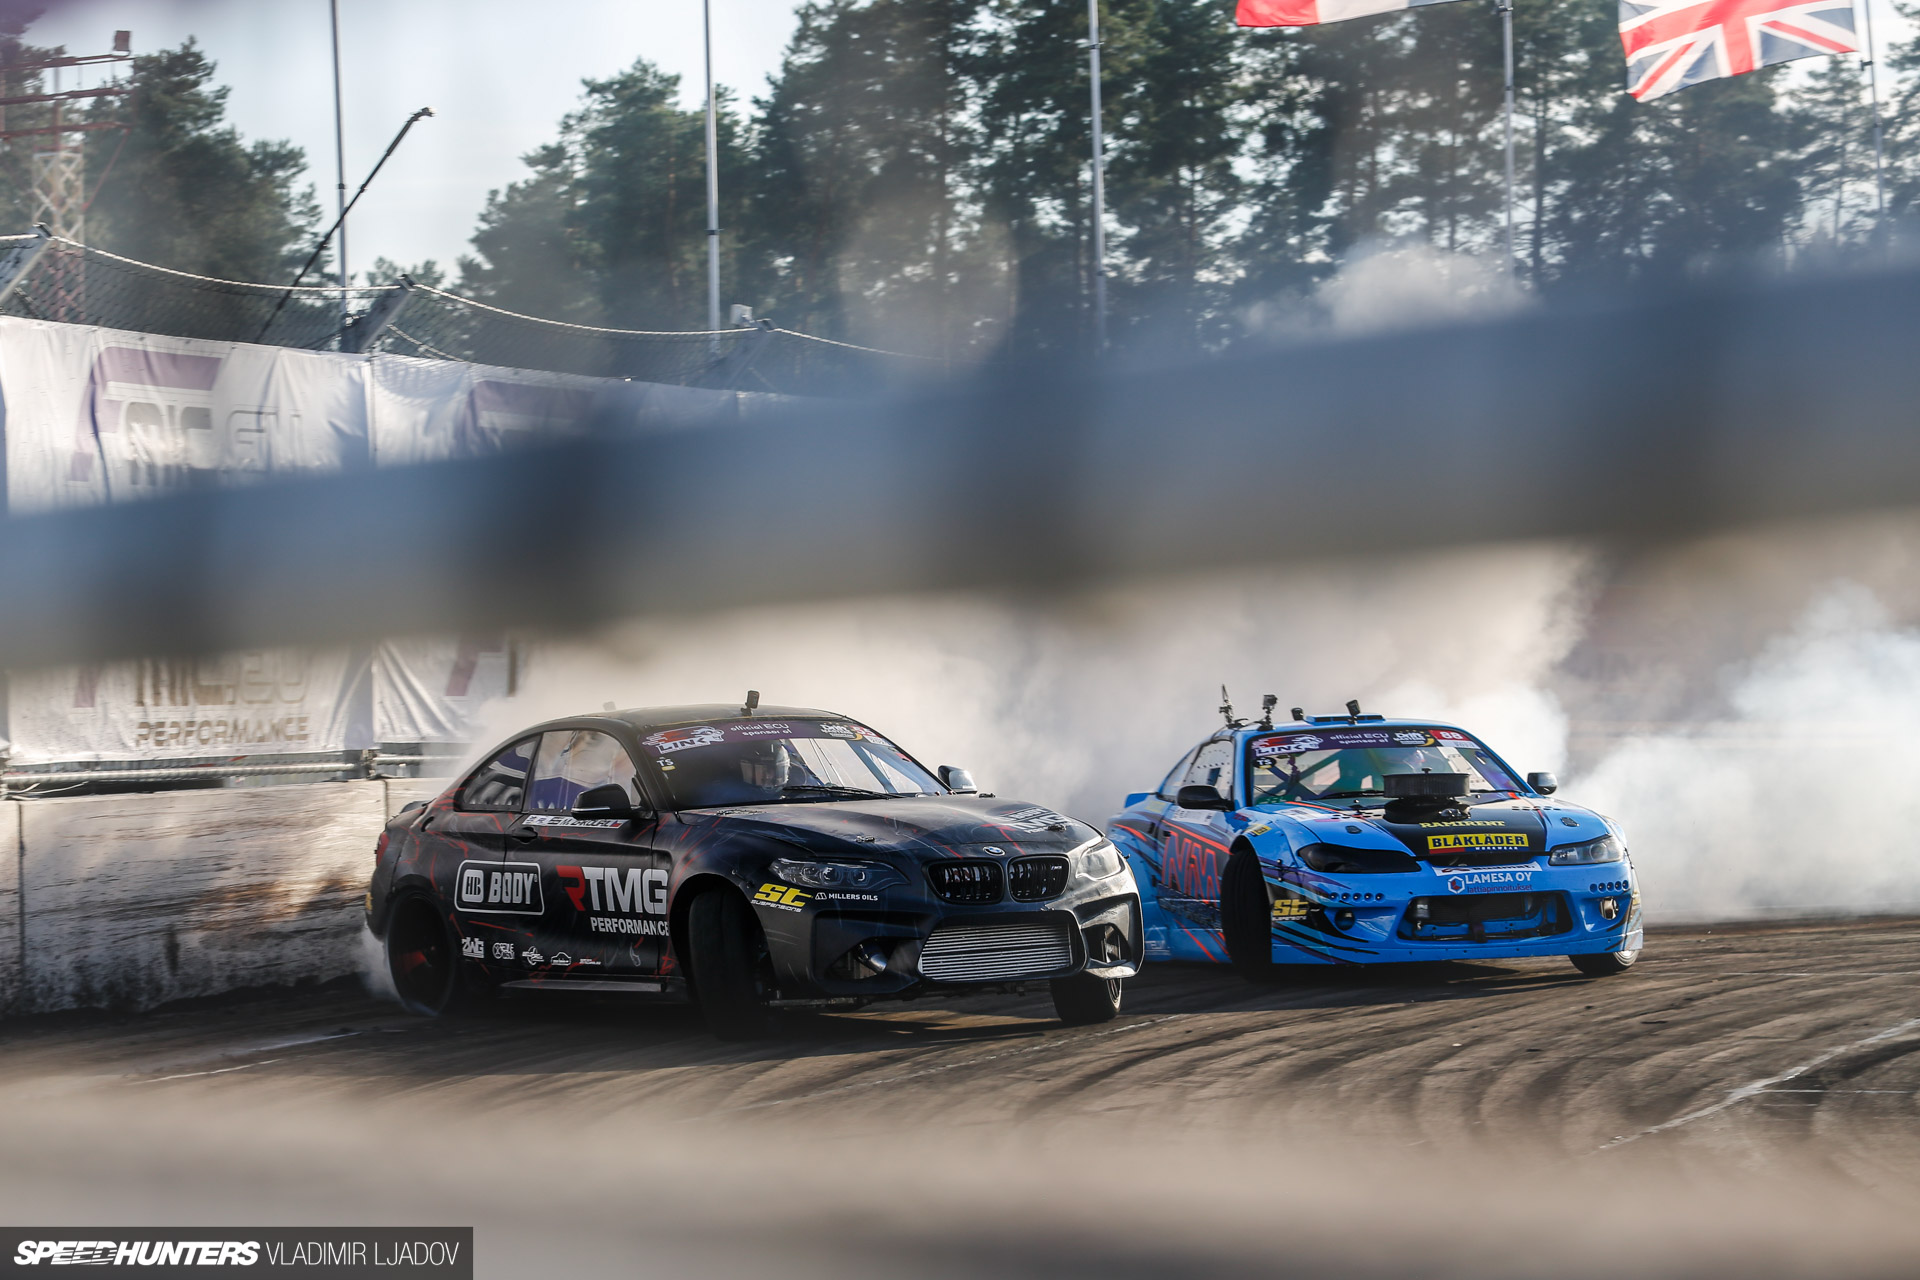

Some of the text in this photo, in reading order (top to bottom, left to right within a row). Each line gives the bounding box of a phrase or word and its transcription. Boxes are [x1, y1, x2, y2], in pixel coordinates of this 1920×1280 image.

[136, 716, 310, 748] PERFORMANCE
[1432, 834, 1525, 848] BLÅKLÄDER
[488, 871, 535, 905] BODY
[555, 865, 669, 915] RTMG
[1465, 871, 1533, 885] LAMESA OY
[590, 916, 670, 937] PERFORMANCE
